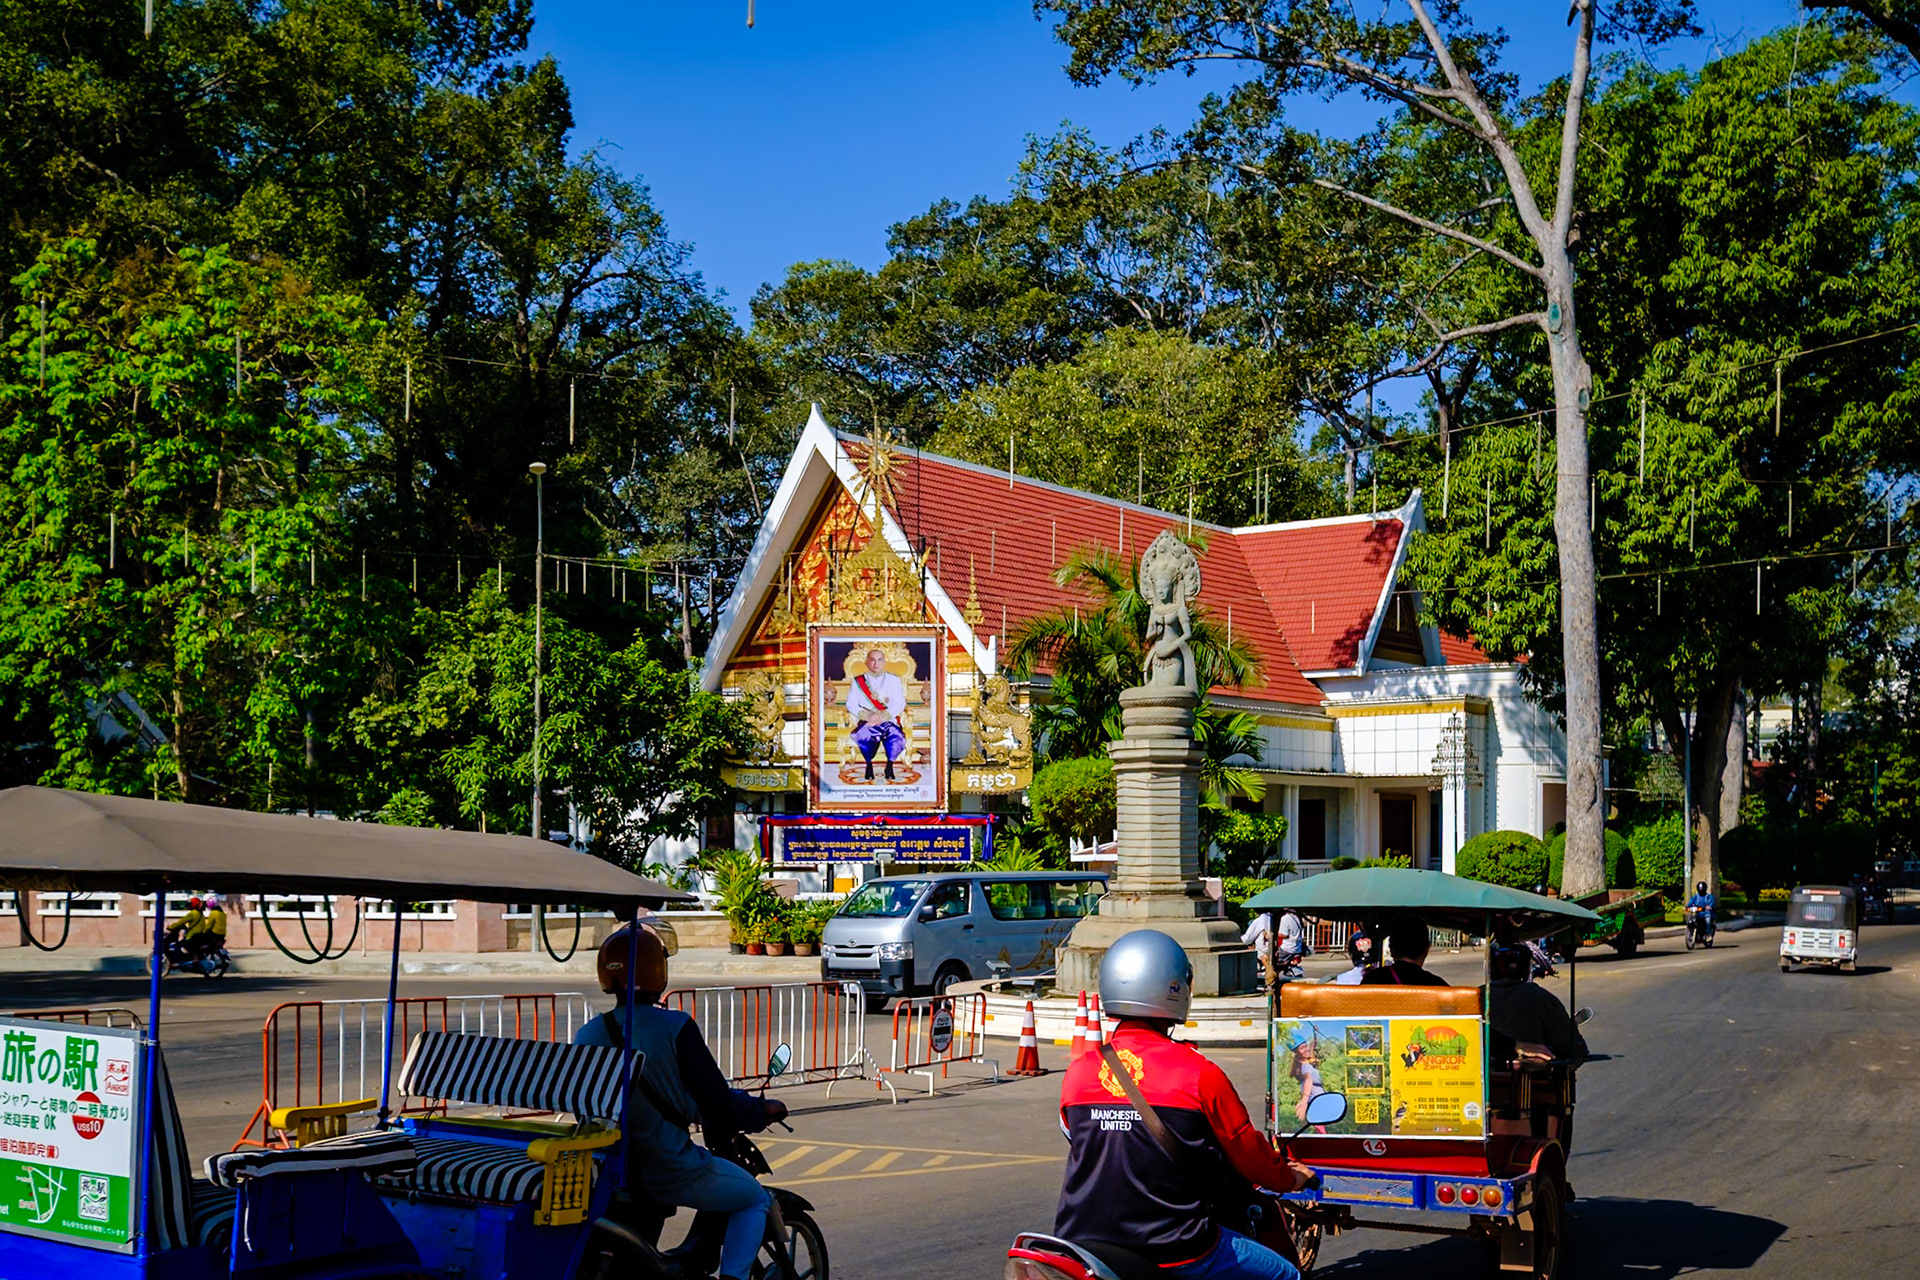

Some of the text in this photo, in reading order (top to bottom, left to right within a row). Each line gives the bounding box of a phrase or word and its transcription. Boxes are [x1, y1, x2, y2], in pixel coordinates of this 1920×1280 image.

[2, 1030, 99, 1092] 旅の駅
[1416, 1053, 1466, 1065] ANGKOR
[1091, 1109, 1142, 1120] MANCHESTE
[43, 1114, 57, 1130] OK
[1101, 1120, 1132, 1131] UNITED
[1364, 1140, 1385, 1152] 14
